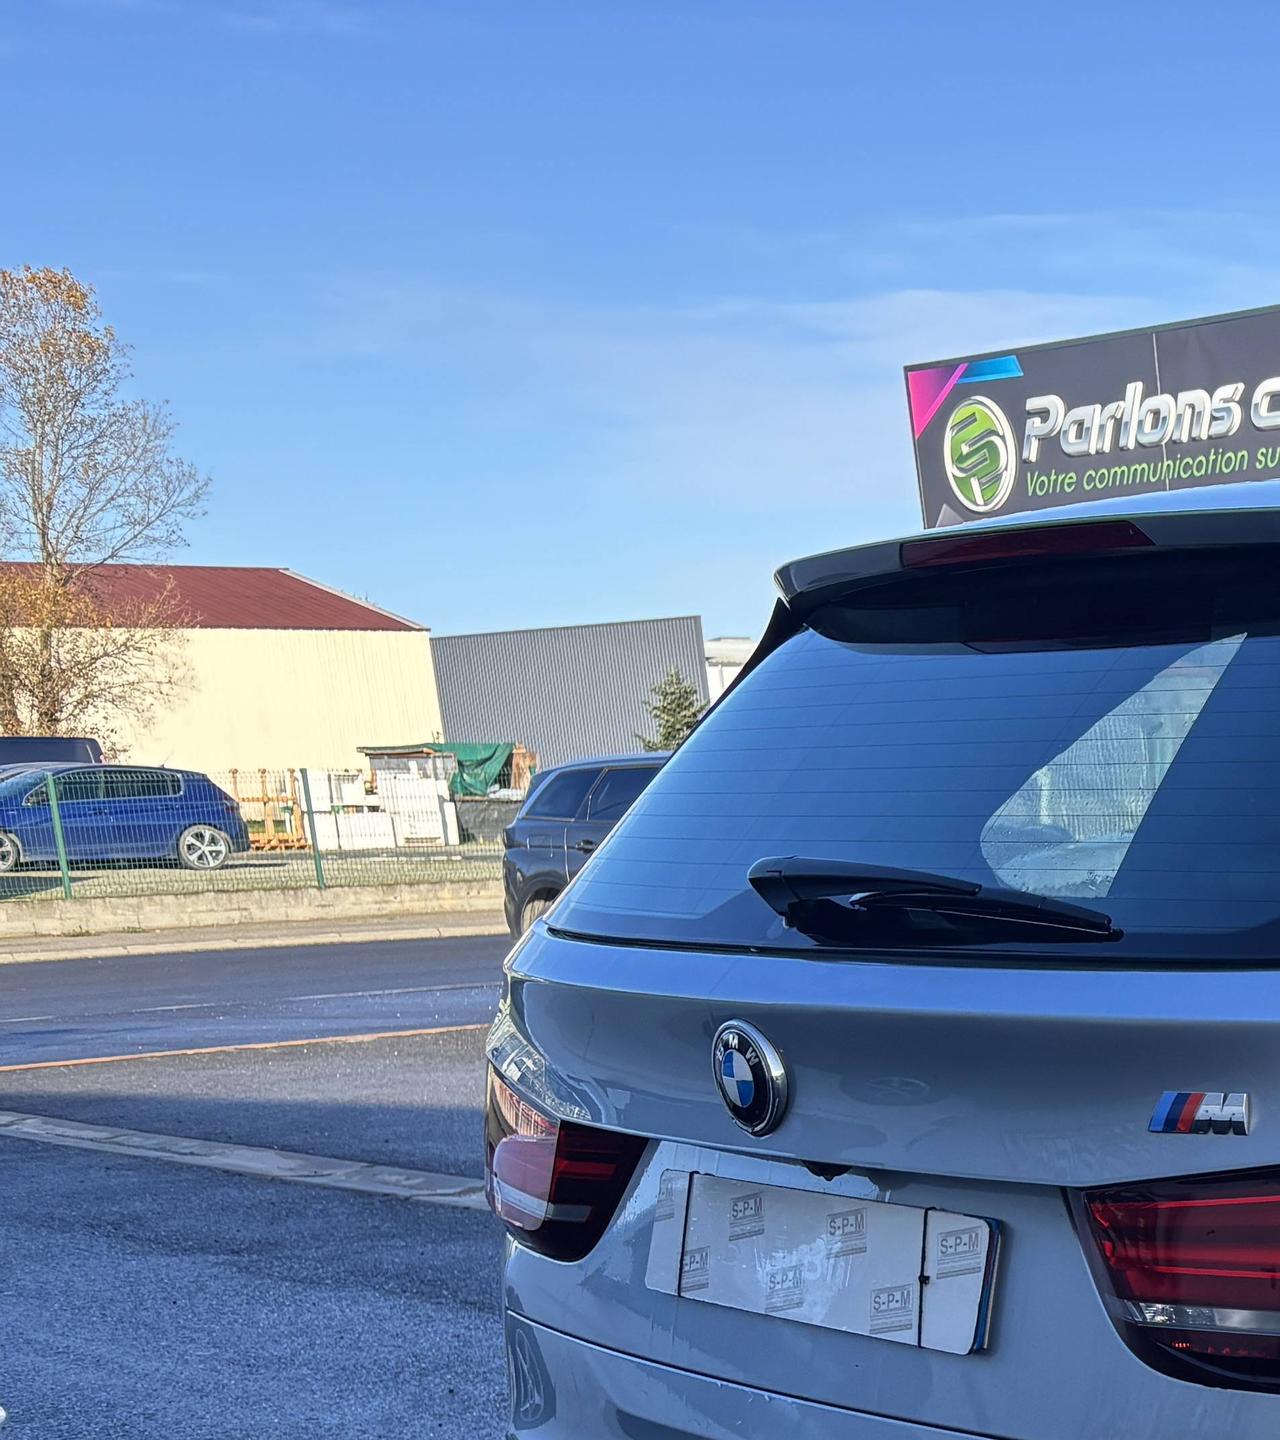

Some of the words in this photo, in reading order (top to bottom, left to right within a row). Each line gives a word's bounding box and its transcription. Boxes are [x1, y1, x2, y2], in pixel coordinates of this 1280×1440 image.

[1022, 380, 1245, 463] Parlons
[1026, 469, 1077, 497] Votre
[1083, 448, 1249, 491] communication
[716, 1033, 760, 1067] BMW
